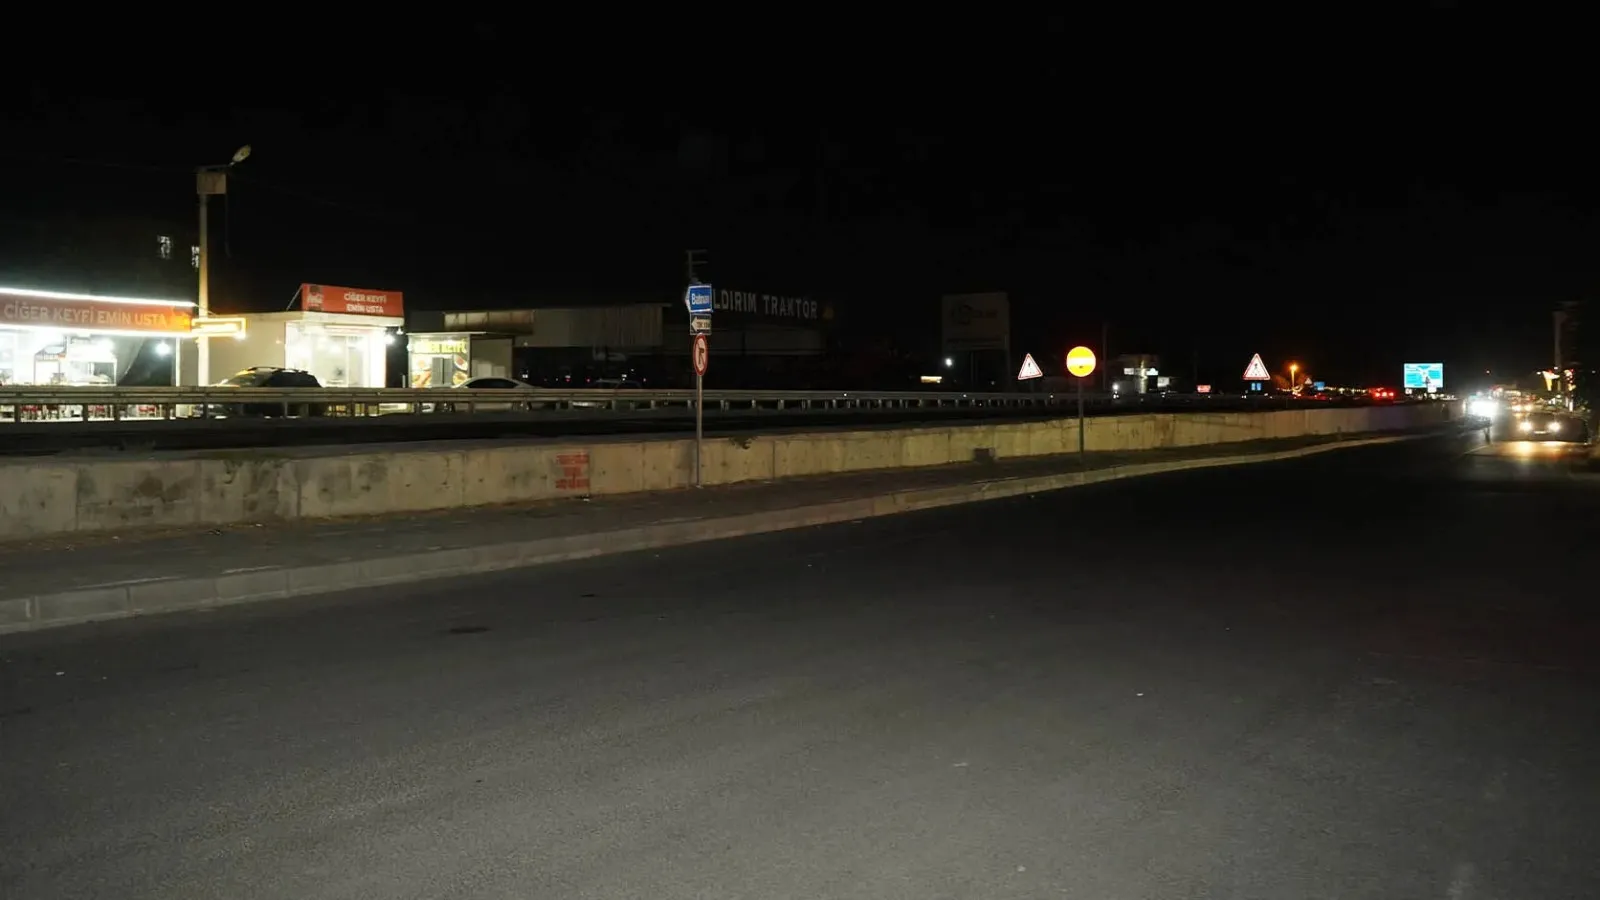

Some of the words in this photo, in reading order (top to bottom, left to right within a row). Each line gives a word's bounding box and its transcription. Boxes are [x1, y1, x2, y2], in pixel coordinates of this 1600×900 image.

[713, 289, 757, 313] LDIRIM
[4, 301, 48, 320] CİĞER
[54, 307, 94, 323] KEYFİ
[97, 309, 131, 326] EMİN
[135, 314, 167, 328] USTA
